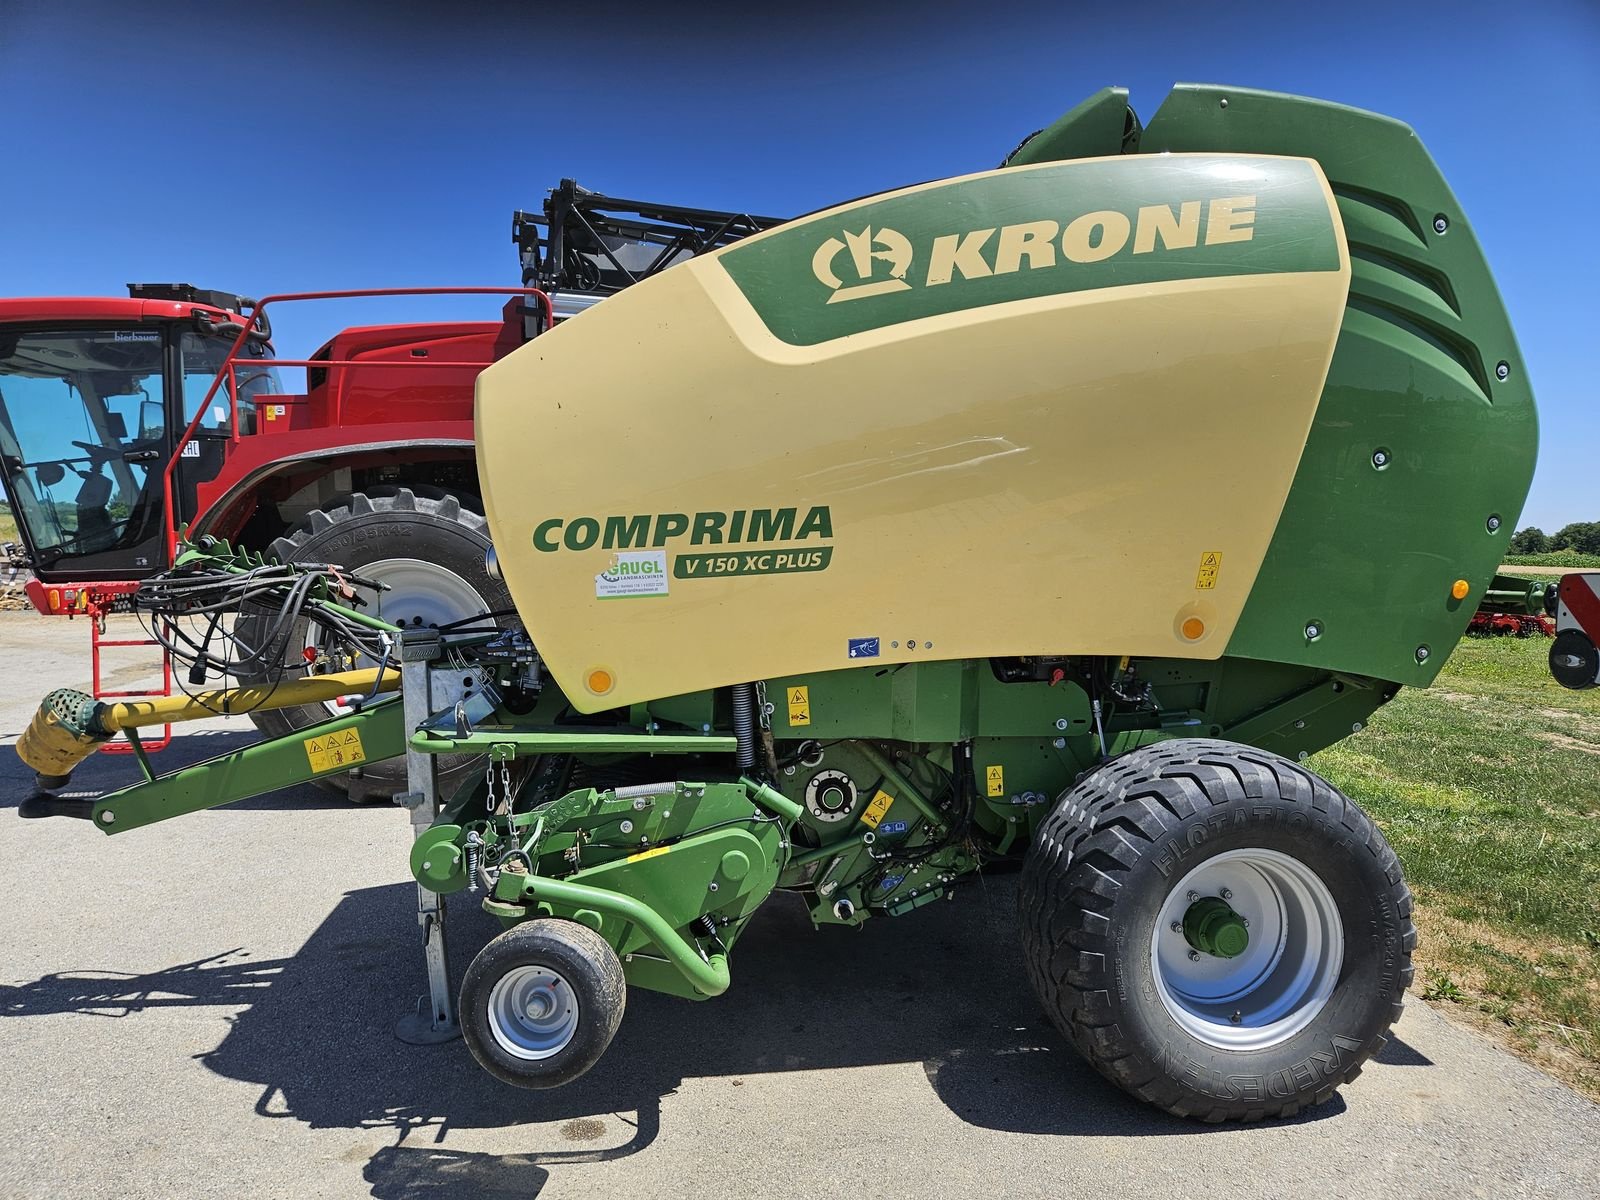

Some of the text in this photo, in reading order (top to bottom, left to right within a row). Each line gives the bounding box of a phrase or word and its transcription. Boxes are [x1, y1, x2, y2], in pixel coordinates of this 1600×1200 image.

[926, 195, 1257, 287] KRONE
[114, 331, 159, 342] bierbauer
[532, 505, 834, 553] COMPRIMA
[685, 552, 822, 574] V 150 XC PLUS
